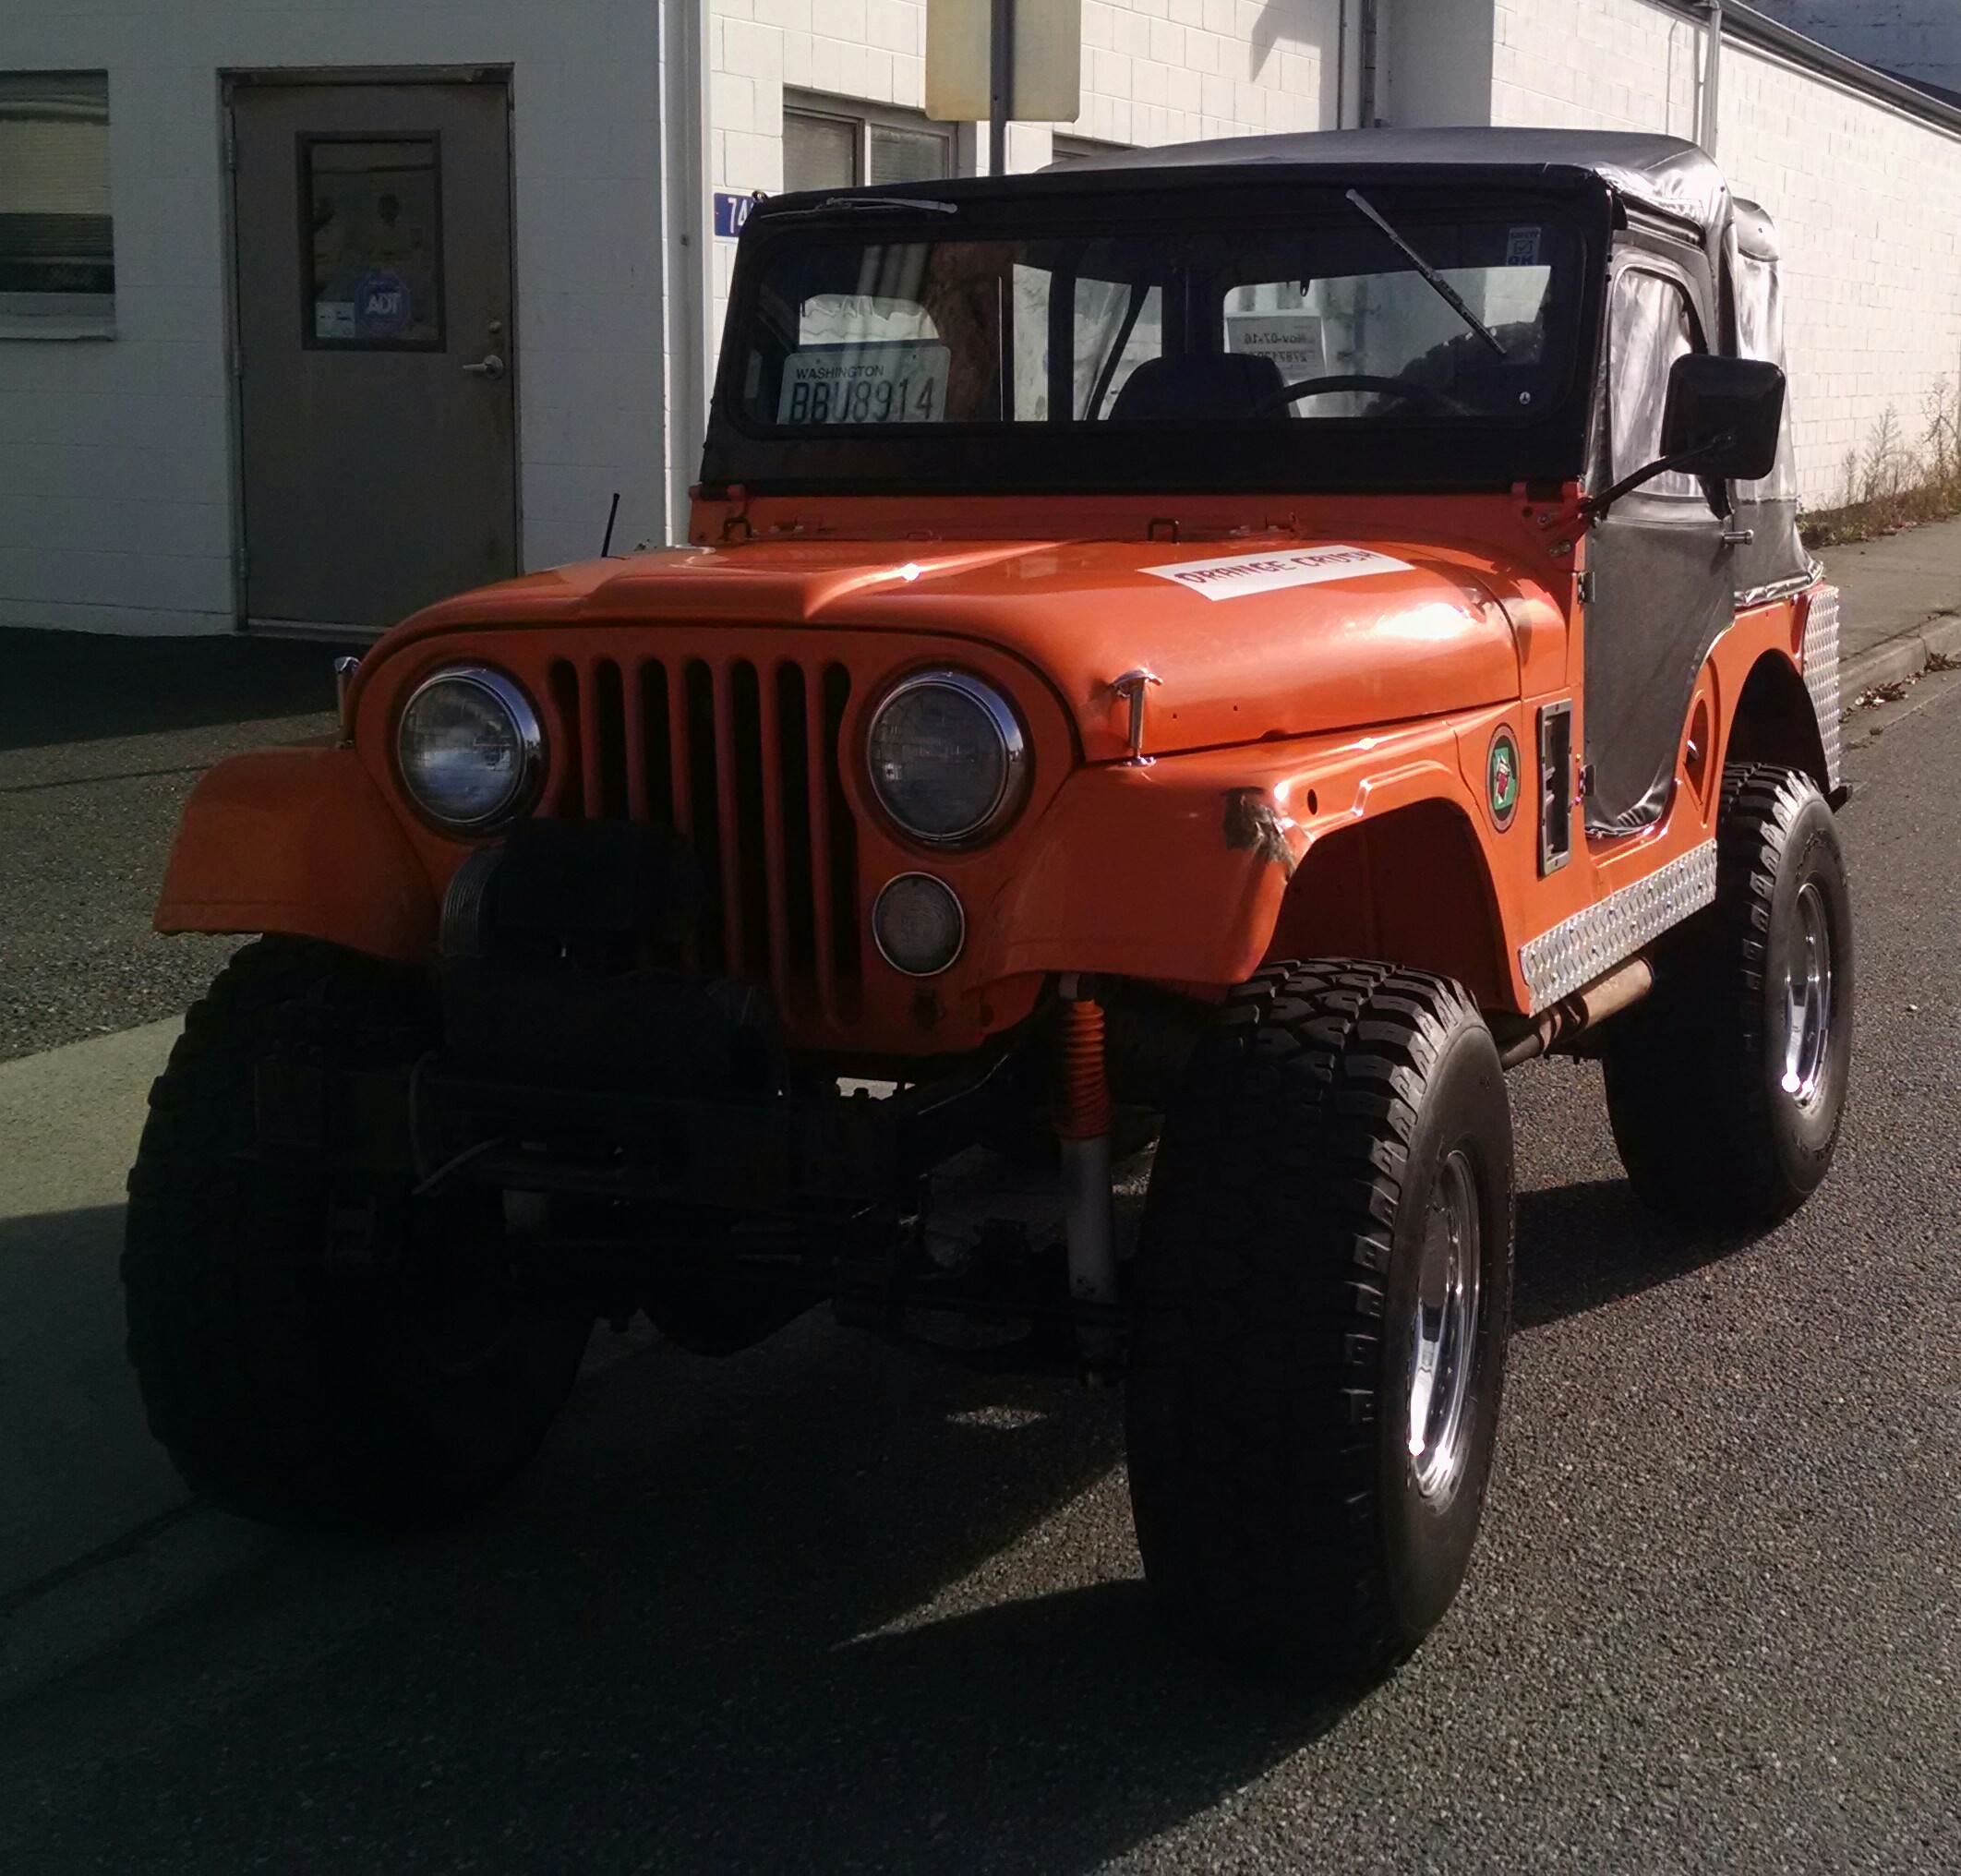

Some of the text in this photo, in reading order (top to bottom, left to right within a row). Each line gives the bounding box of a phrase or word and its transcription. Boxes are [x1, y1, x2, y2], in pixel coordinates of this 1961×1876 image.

[728, 197, 754, 234] 74
[366, 293, 402, 315] ADT
[796, 365, 884, 380] WASHINGTON
[789, 378, 933, 422] BBU8914
[1173, 551, 1382, 583] ORANGE CRUSH
